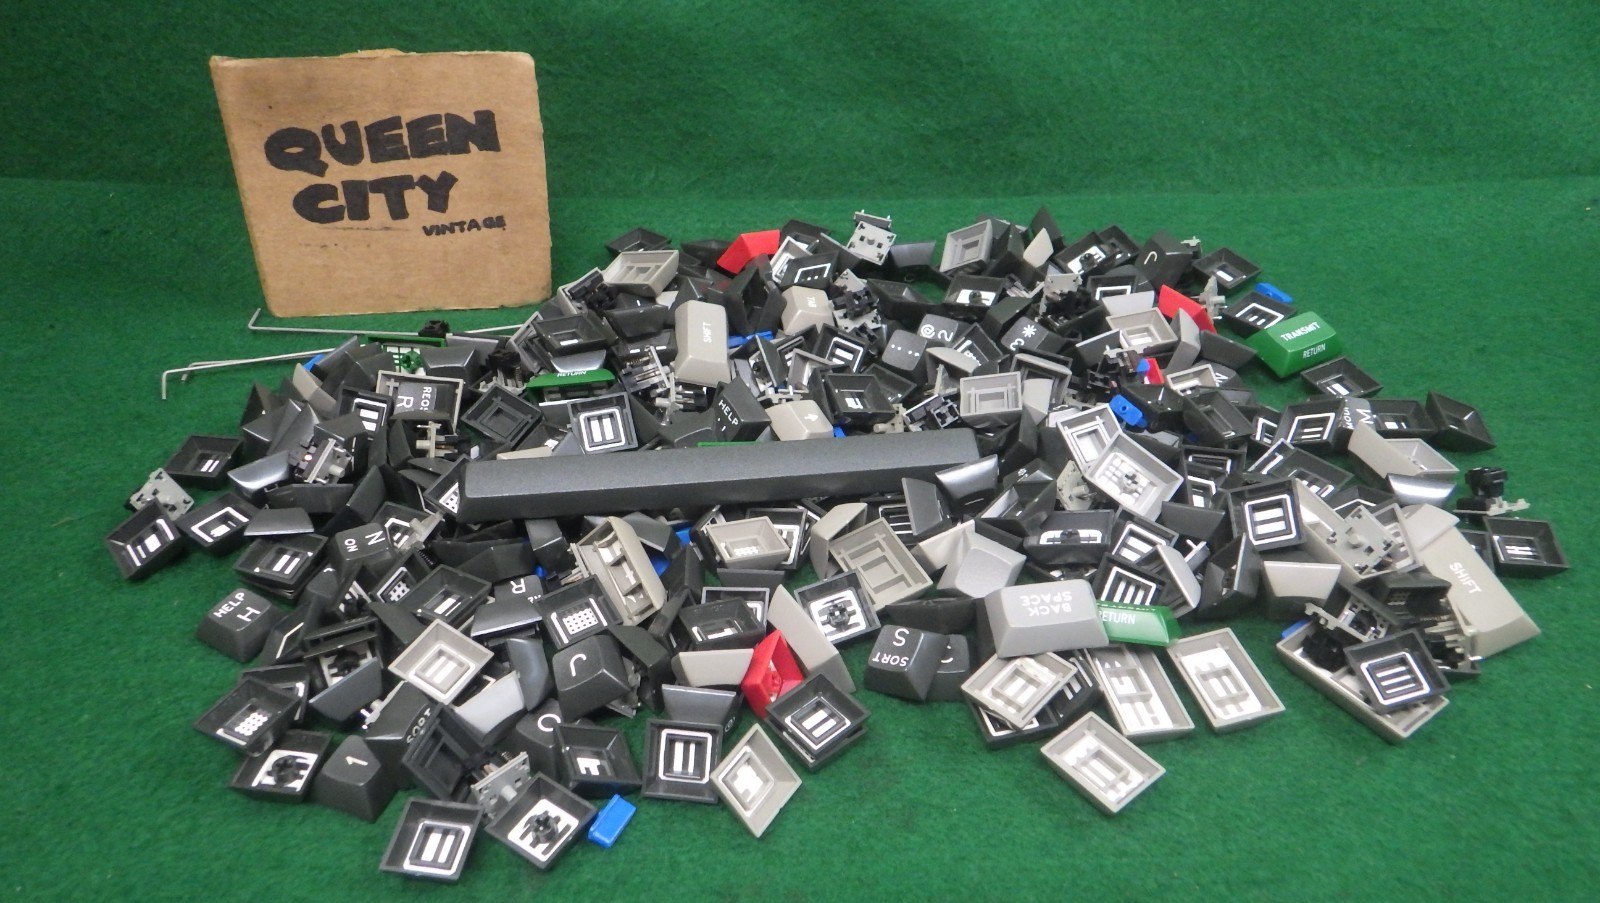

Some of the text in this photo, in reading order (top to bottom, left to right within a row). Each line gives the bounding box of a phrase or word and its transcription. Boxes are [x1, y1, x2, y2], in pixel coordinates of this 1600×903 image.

[264, 110, 501, 177] QUEEN
[292, 171, 458, 224] CITY
[422, 215, 506, 236] VINTAGE
[703, 321, 712, 343] SHIFT
[920, 324, 935, 338] @
[1280, 321, 1320, 341] TRANSMIT
[1302, 343, 1326, 359] RETURN
[396, 395, 414, 409] R
[718, 400, 739, 426] HELP
[1355, 408, 1375, 425] M
[364, 530, 386, 546] N
[510, 578, 526, 594] R
[1449, 562, 1482, 593] SHIFT
[213, 592, 245, 618] HELP
[1020, 591, 1073, 606] SPACE
[236, 606, 262, 622] H
[1028, 603, 1072, 617] BACK
[892, 628, 910, 647] S
[569, 653, 587, 677] J
[872, 652, 910, 667] SORT
